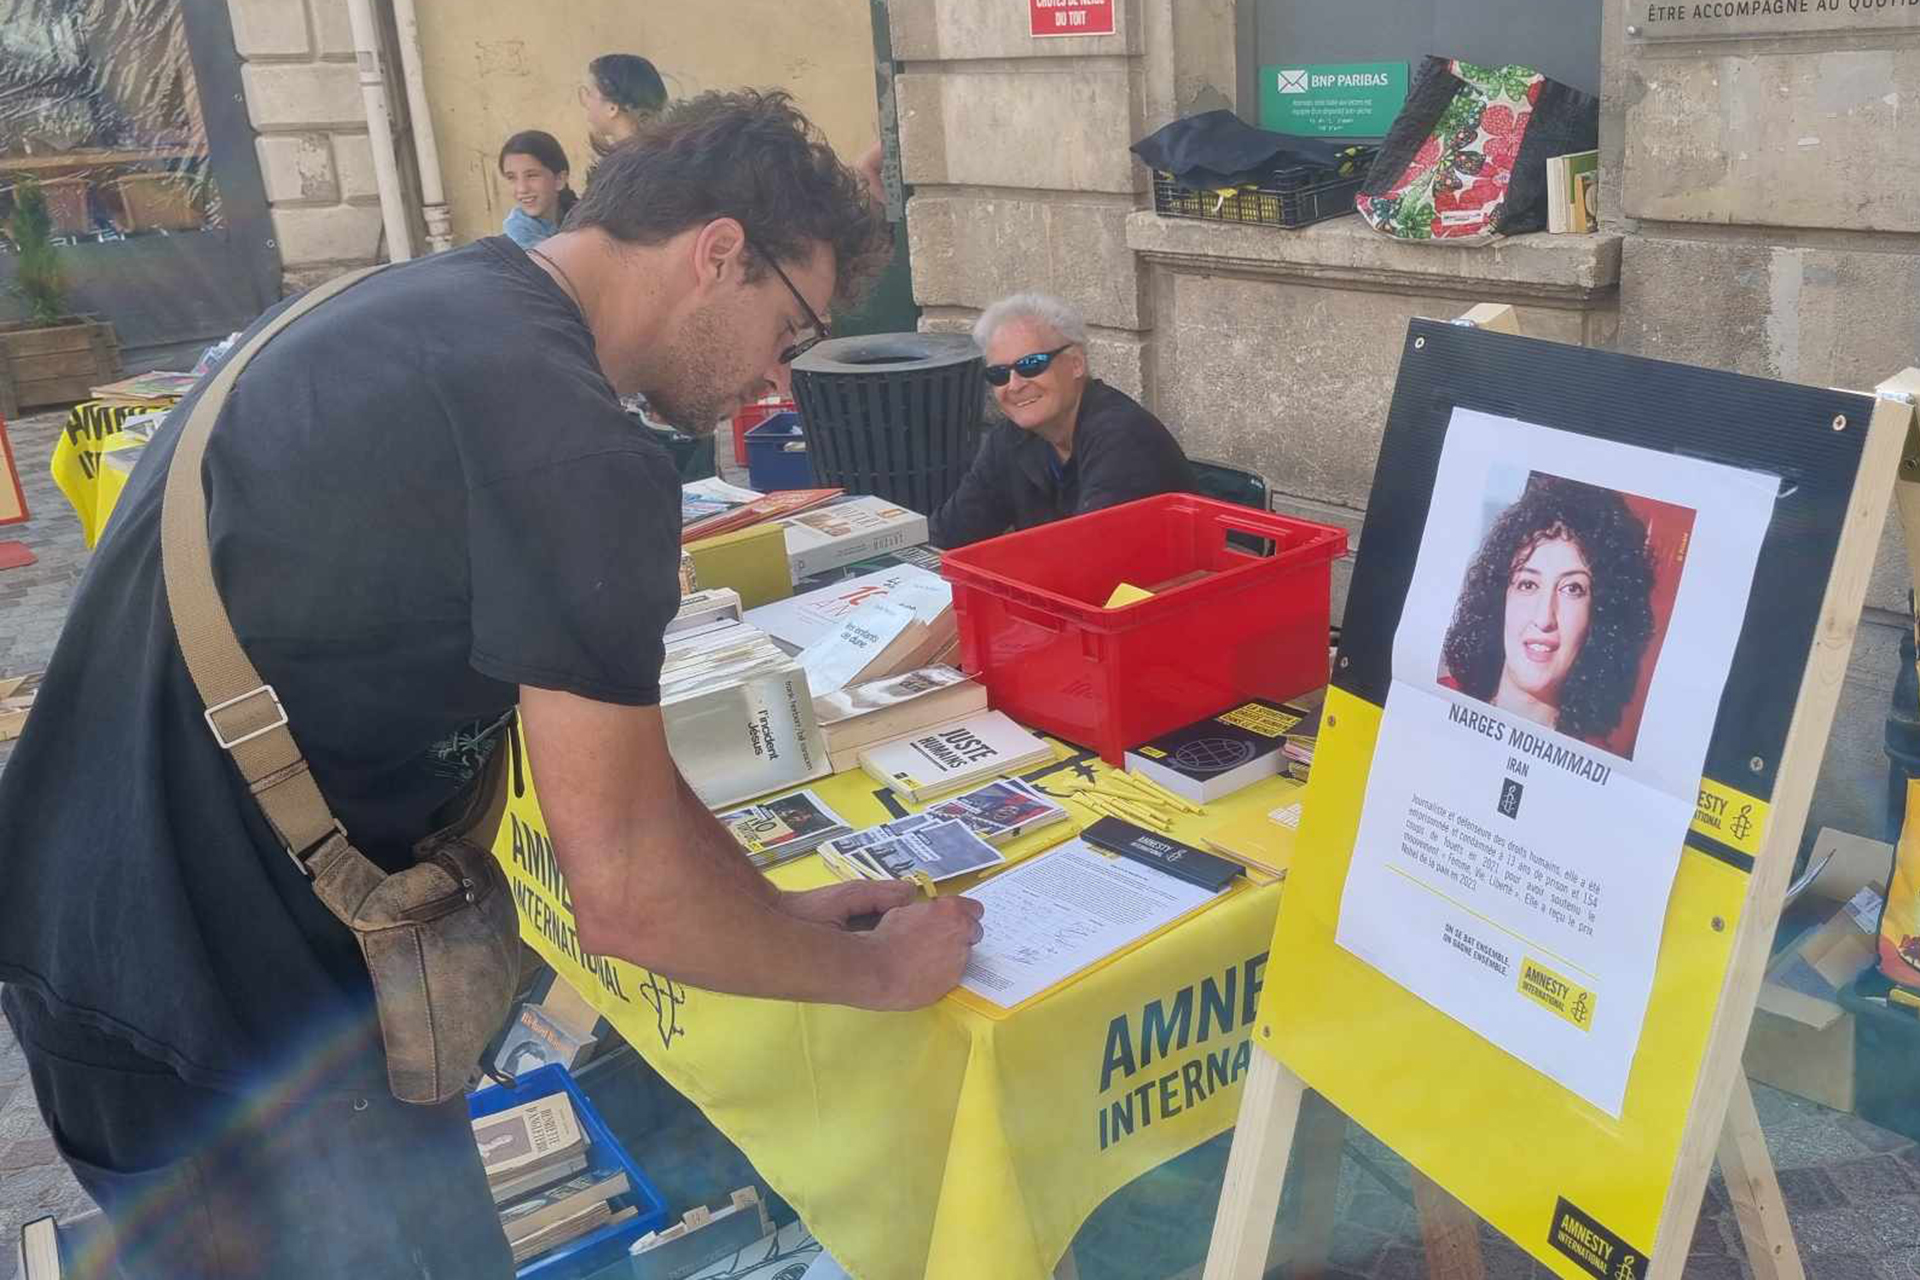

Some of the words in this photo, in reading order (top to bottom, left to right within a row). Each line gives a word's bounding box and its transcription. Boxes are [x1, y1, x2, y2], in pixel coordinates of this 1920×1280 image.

[1055, 11, 1067, 26] DU
[1068, 10, 1087, 26] TOIT
[1648, 4, 1686, 22] ÊTRE
[1817, 0, 1839, 11] AU
[1311, 74, 1336, 88] BNP
[1337, 73, 1389, 86] PARIBAS
[748, 722, 763, 756] Jésus
[758, 709, 781, 760] l'incident
[938, 728, 998, 762] JUSTE
[1449, 703, 1506, 741] NARGES
[1508, 728, 1611, 786] MOHAMMADI
[917, 736, 968, 768] HUMAINS
[1506, 756, 1529, 777] IRAN
[1138, 836, 1172, 853] AMNESTY
[1401, 842, 1419, 859] Nobel
[1507, 840, 1527, 859] droits
[1564, 869, 1579, 883] elle
[1579, 878, 1586, 888] a
[1588, 881, 1600, 895] été
[1507, 853, 1516, 867] 13
[1518, 862, 1531, 875] ans
[1533, 869, 1544, 881] de
[1545, 876, 1569, 894] prison
[1571, 889, 1580, 899] et
[1583, 892, 1598, 908] 154
[1482, 856, 1499, 874] 2021
[1504, 871, 1521, 885] pour
[1550, 894, 1581, 916] soutenu
[1588, 910, 1596, 922] le
[1524, 893, 1539, 909] Elle
[1541, 902, 1547, 912] a
[1549, 907, 1566, 923] reçu
[1567, 915, 1576, 926] le
[513, 876, 631, 1003] INTERNATIONAL
[1444, 923, 1454, 934] ON
[1455, 928, 1463, 940] SE
[1463, 933, 1476, 947] BAT
[1522, 980, 1566, 1012] INTERNATIONAL
[1525, 966, 1570, 999] AMNESTY
[1099, 950, 1270, 1094] AMNE
[1100, 1039, 1250, 1152] INTERNA
[1558, 1229, 1608, 1275] INTERNATIONAL
[1561, 1214, 1614, 1260] AMNESTY
